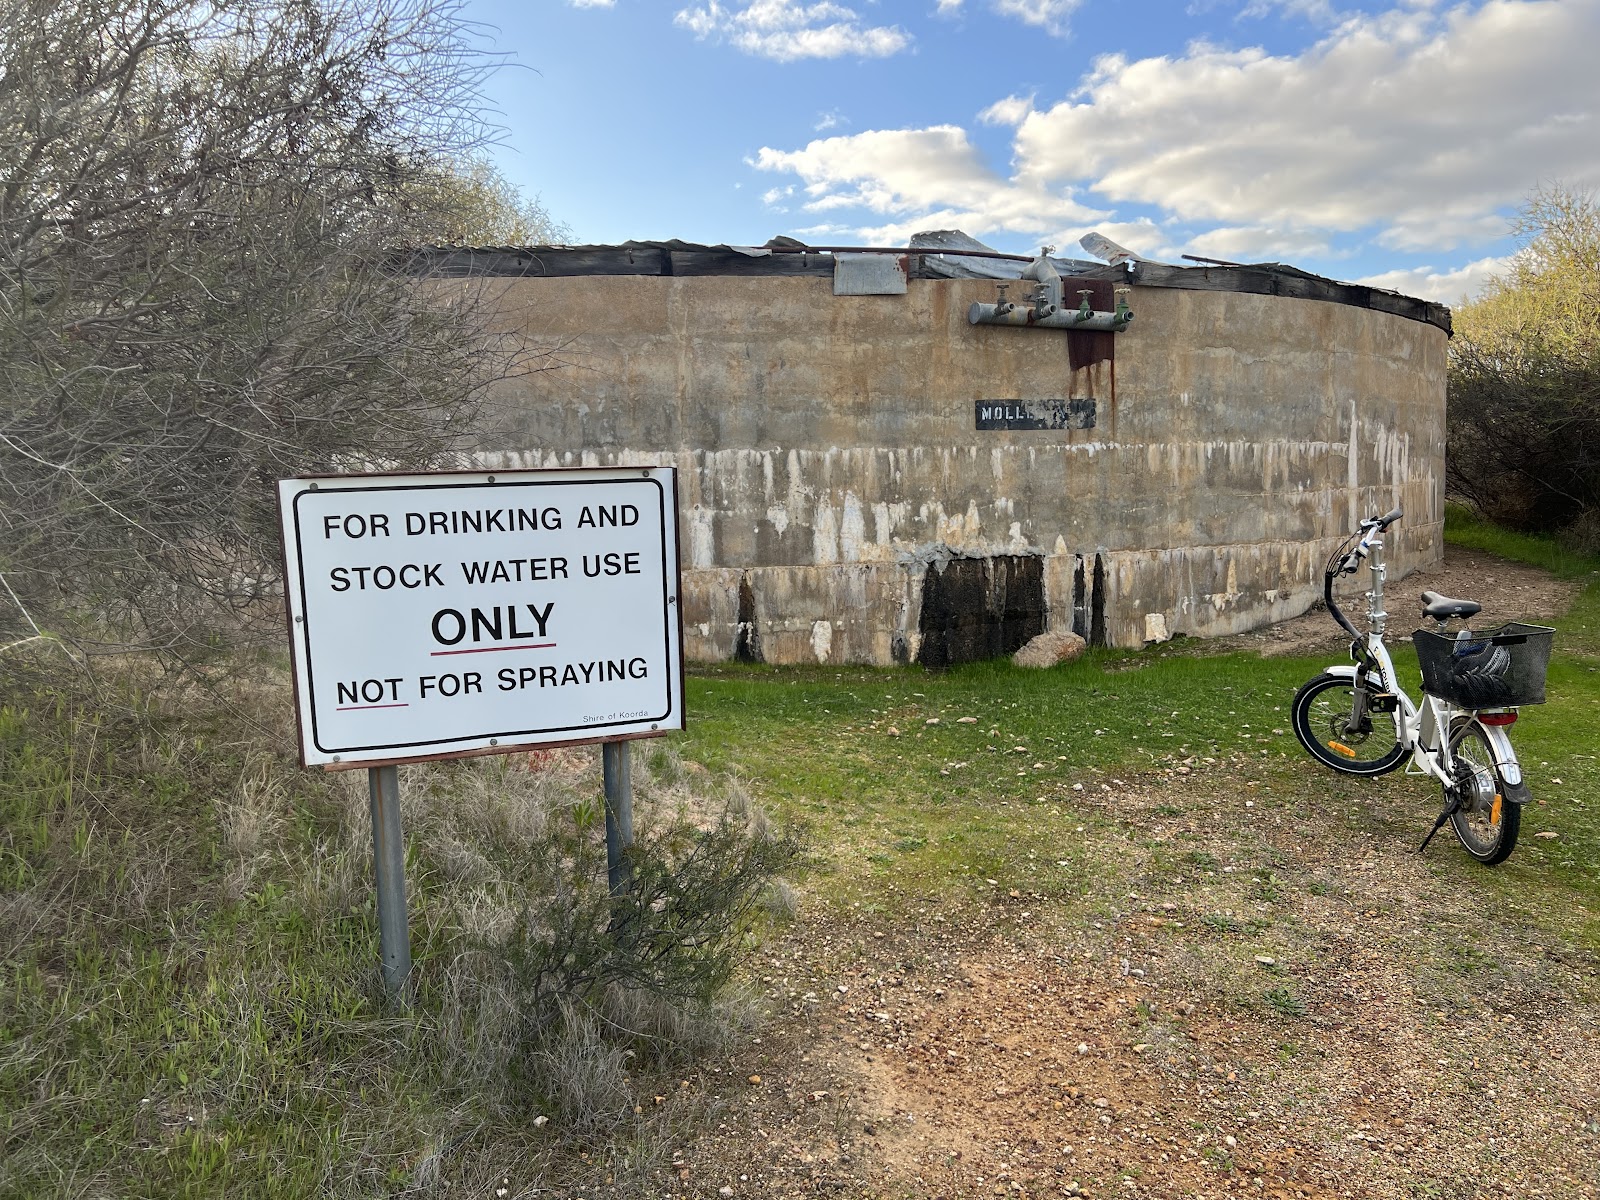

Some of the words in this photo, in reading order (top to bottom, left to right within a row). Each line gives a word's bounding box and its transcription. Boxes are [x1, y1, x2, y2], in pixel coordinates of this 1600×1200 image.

[323, 513, 390, 539] FOR
[405, 507, 562, 536] DRINKING
[577, 504, 640, 529] AND
[330, 563, 445, 592] STOCK
[460, 556, 568, 585] WATER
[582, 552, 641, 578] USE
[431, 602, 555, 646] ONLY
[336, 677, 404, 705] NOT
[419, 671, 483, 699] FOR
[497, 657, 648, 692] SPRAYING
[582, 715, 605, 723] Shire
[607, 712, 616, 720] of
[619, 709, 649, 718] Koorda
